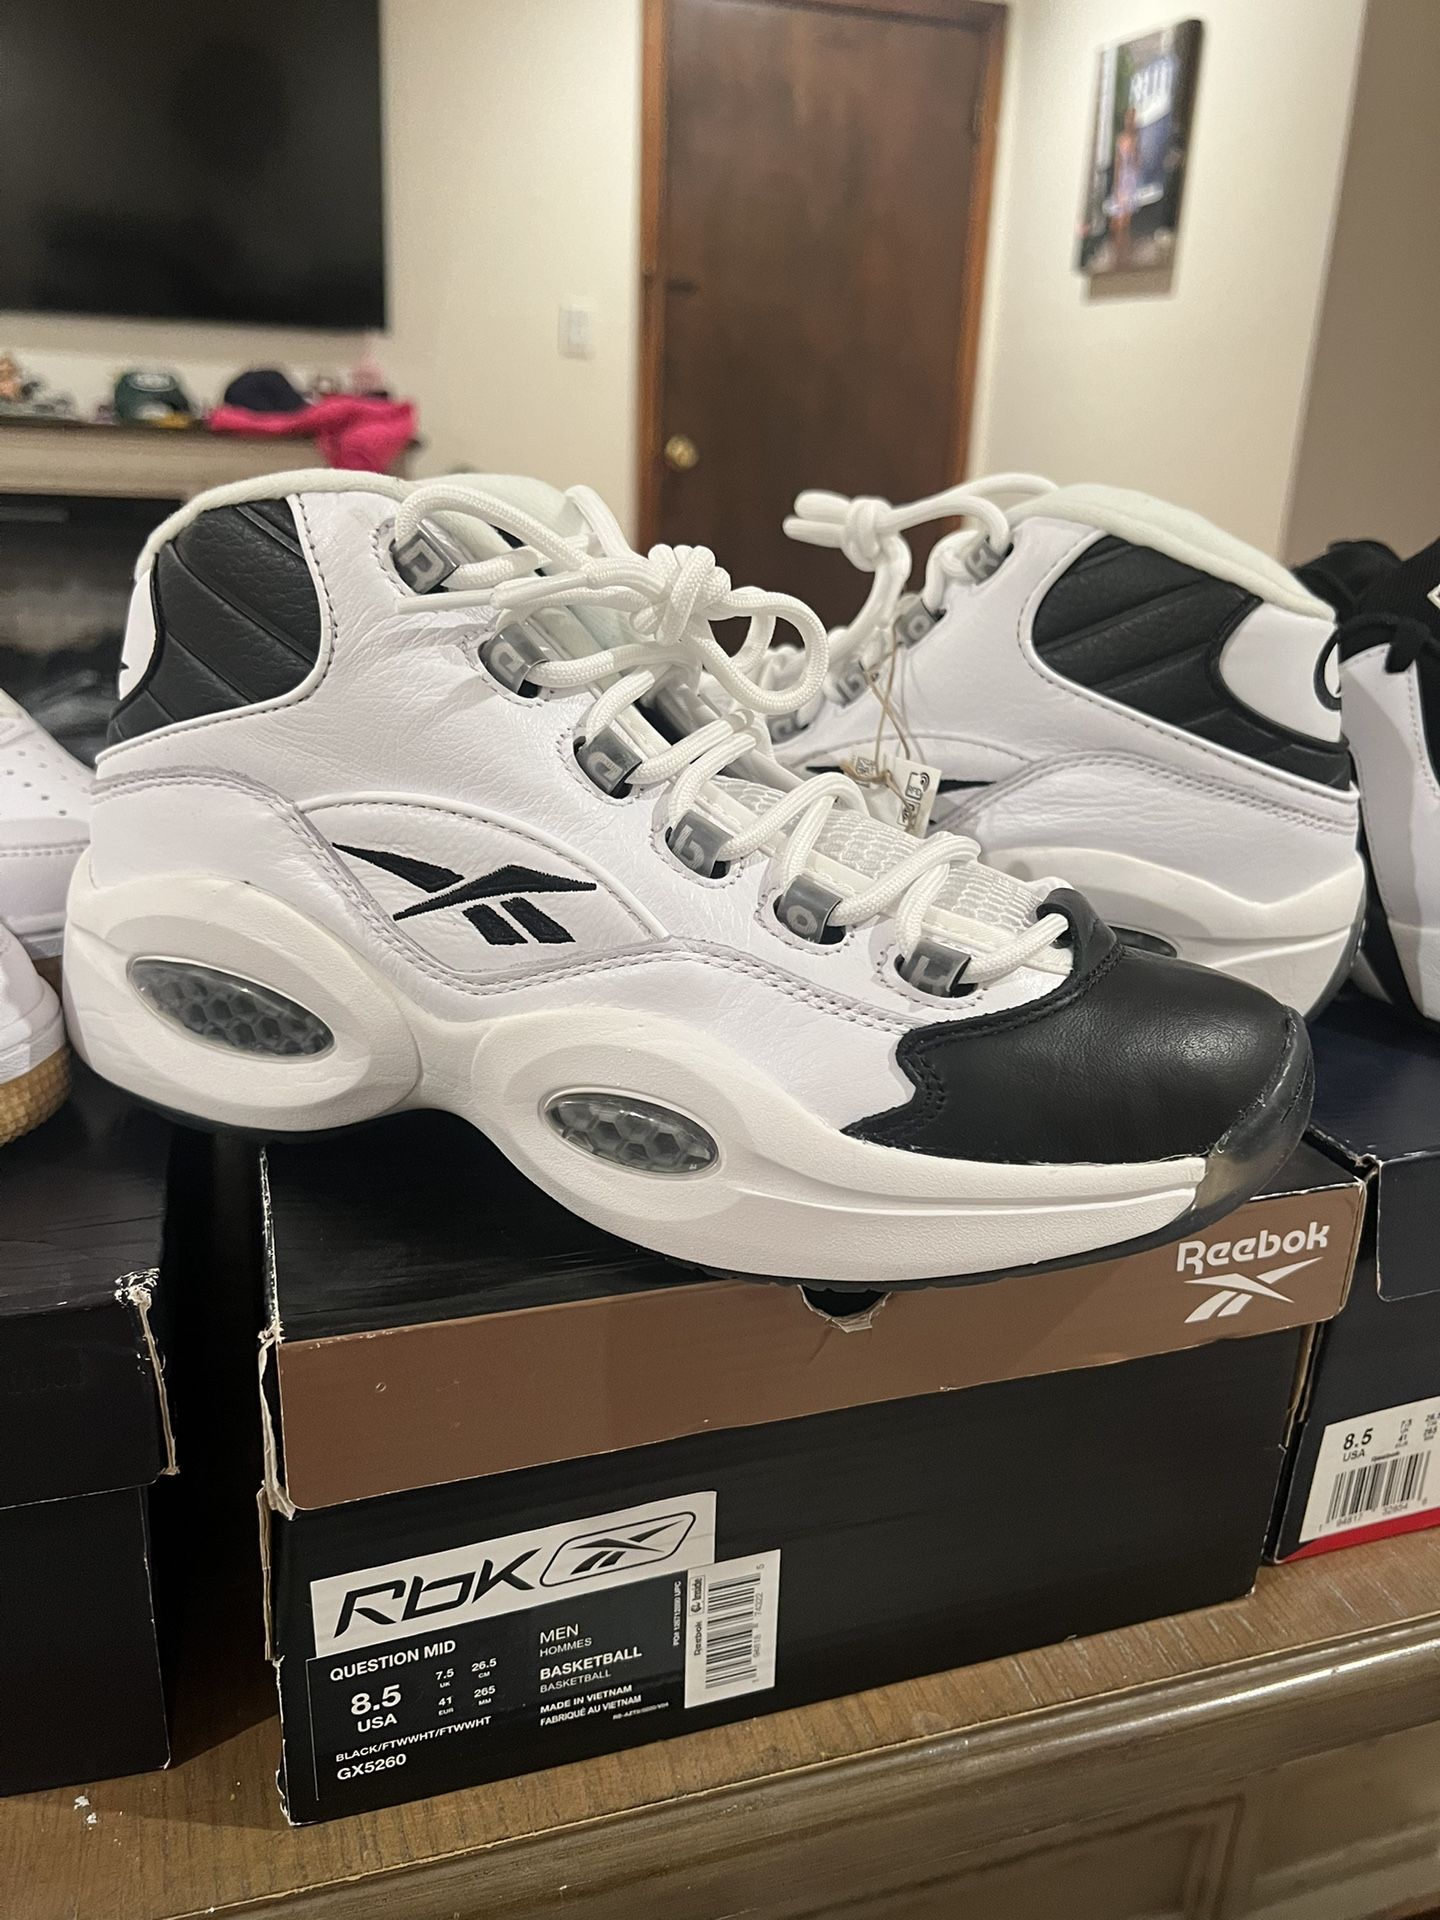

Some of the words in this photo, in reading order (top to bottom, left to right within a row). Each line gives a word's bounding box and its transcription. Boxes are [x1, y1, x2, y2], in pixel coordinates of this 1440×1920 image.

[1176, 1221, 1330, 1275] Reebok
[1343, 1428, 1373, 1450] 8.5
[1342, 1449, 1365, 1462] USA
[540, 1623, 579, 1645] MEN
[540, 1637, 592, 1658] HOMMES
[329, 1651, 419, 1683] QUESTION
[423, 1639, 456, 1661] MID
[435, 1668, 455, 1681] 7.5
[471, 1657, 497, 1672] 26.5
[540, 1646, 643, 1681] BASKETBALL
[478, 1671, 491, 1679] CM
[540, 1668, 612, 1693] BASKETBALL
[350, 1684, 402, 1717] 8.5
[438, 1696, 453, 1707] 41
[473, 1685, 496, 1699] 265
[540, 1699, 571, 1714] MADE
[573, 1695, 585, 1706] IN
[586, 1684, 633, 1702] VIETNAM
[587, 1704, 601, 1715] AU
[602, 1694, 642, 1712] VIETNAM
[438, 1707, 454, 1716] EUR
[357, 1713, 397, 1734] USA
[336, 1715, 493, 1763] BLACK/FTWWHT/FTWWHT
[337, 1753, 407, 1781] GX5260
